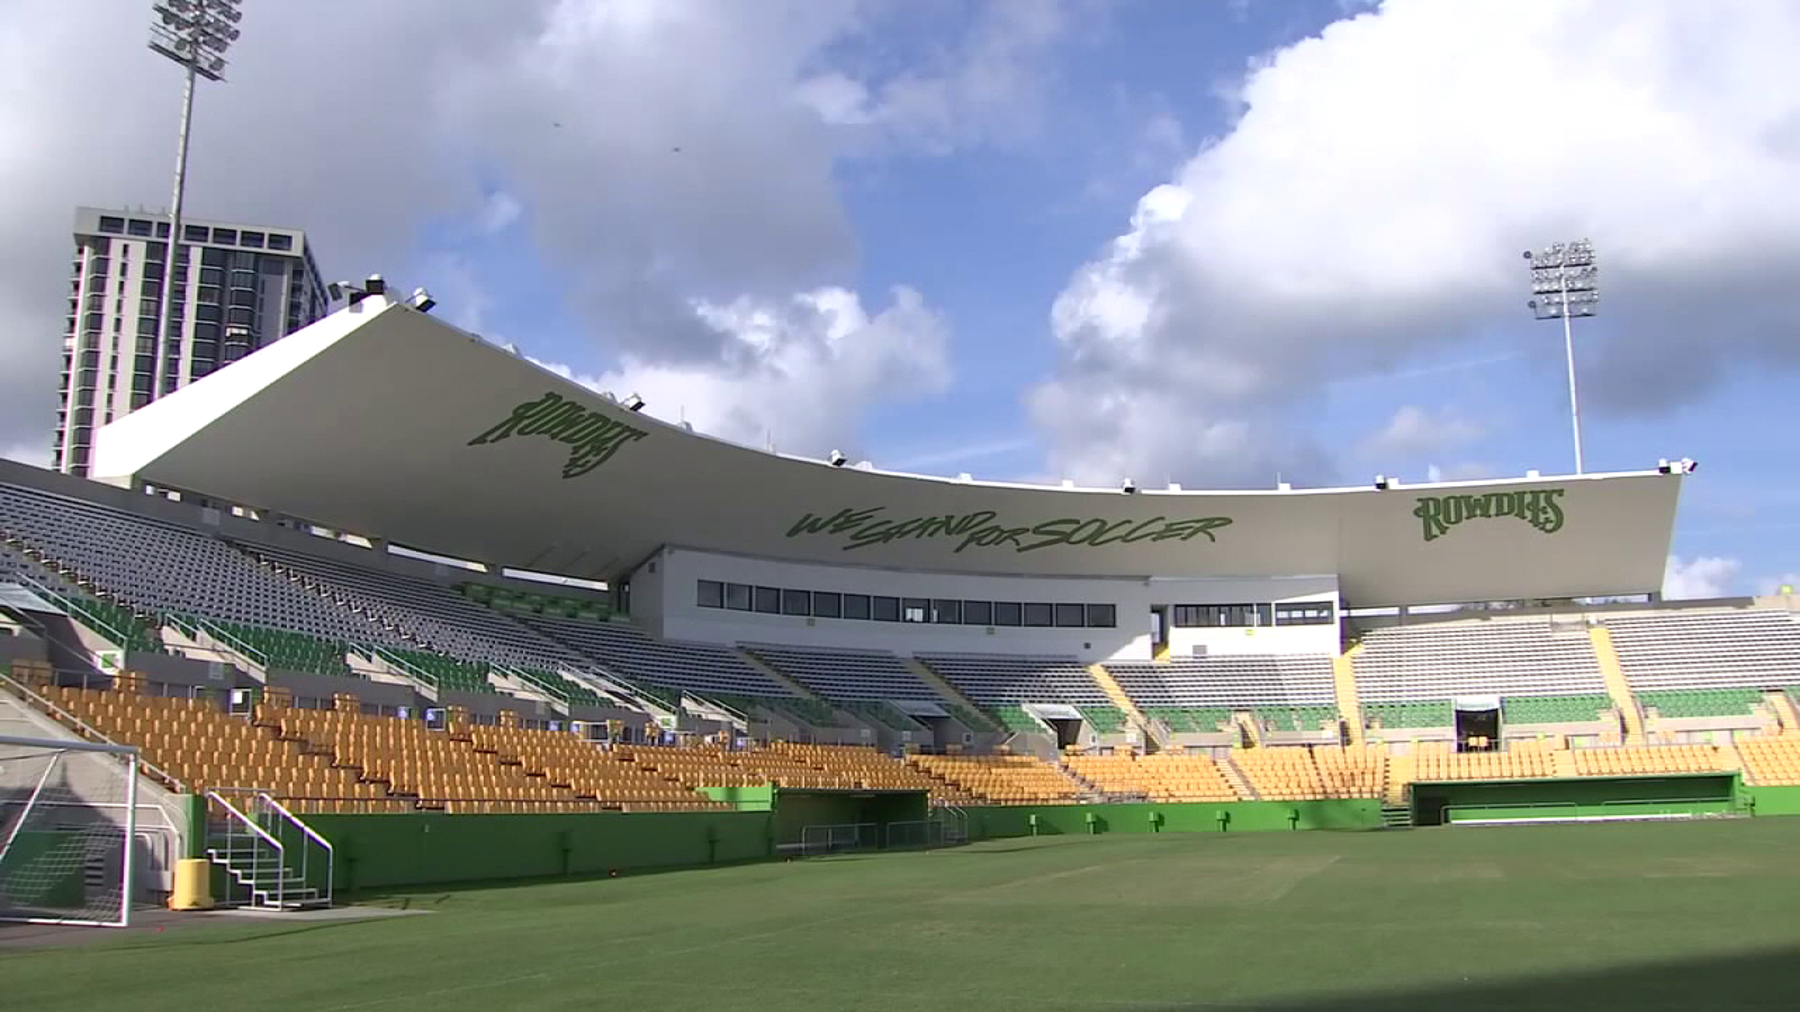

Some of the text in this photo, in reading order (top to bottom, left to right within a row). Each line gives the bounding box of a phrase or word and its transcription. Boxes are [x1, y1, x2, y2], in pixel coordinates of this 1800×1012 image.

[467, 391, 649, 479] ROWDIES
[786, 506, 1233, 553] WE STAND FOR SOCCER
[1413, 488, 1565, 541] ROWDIES
